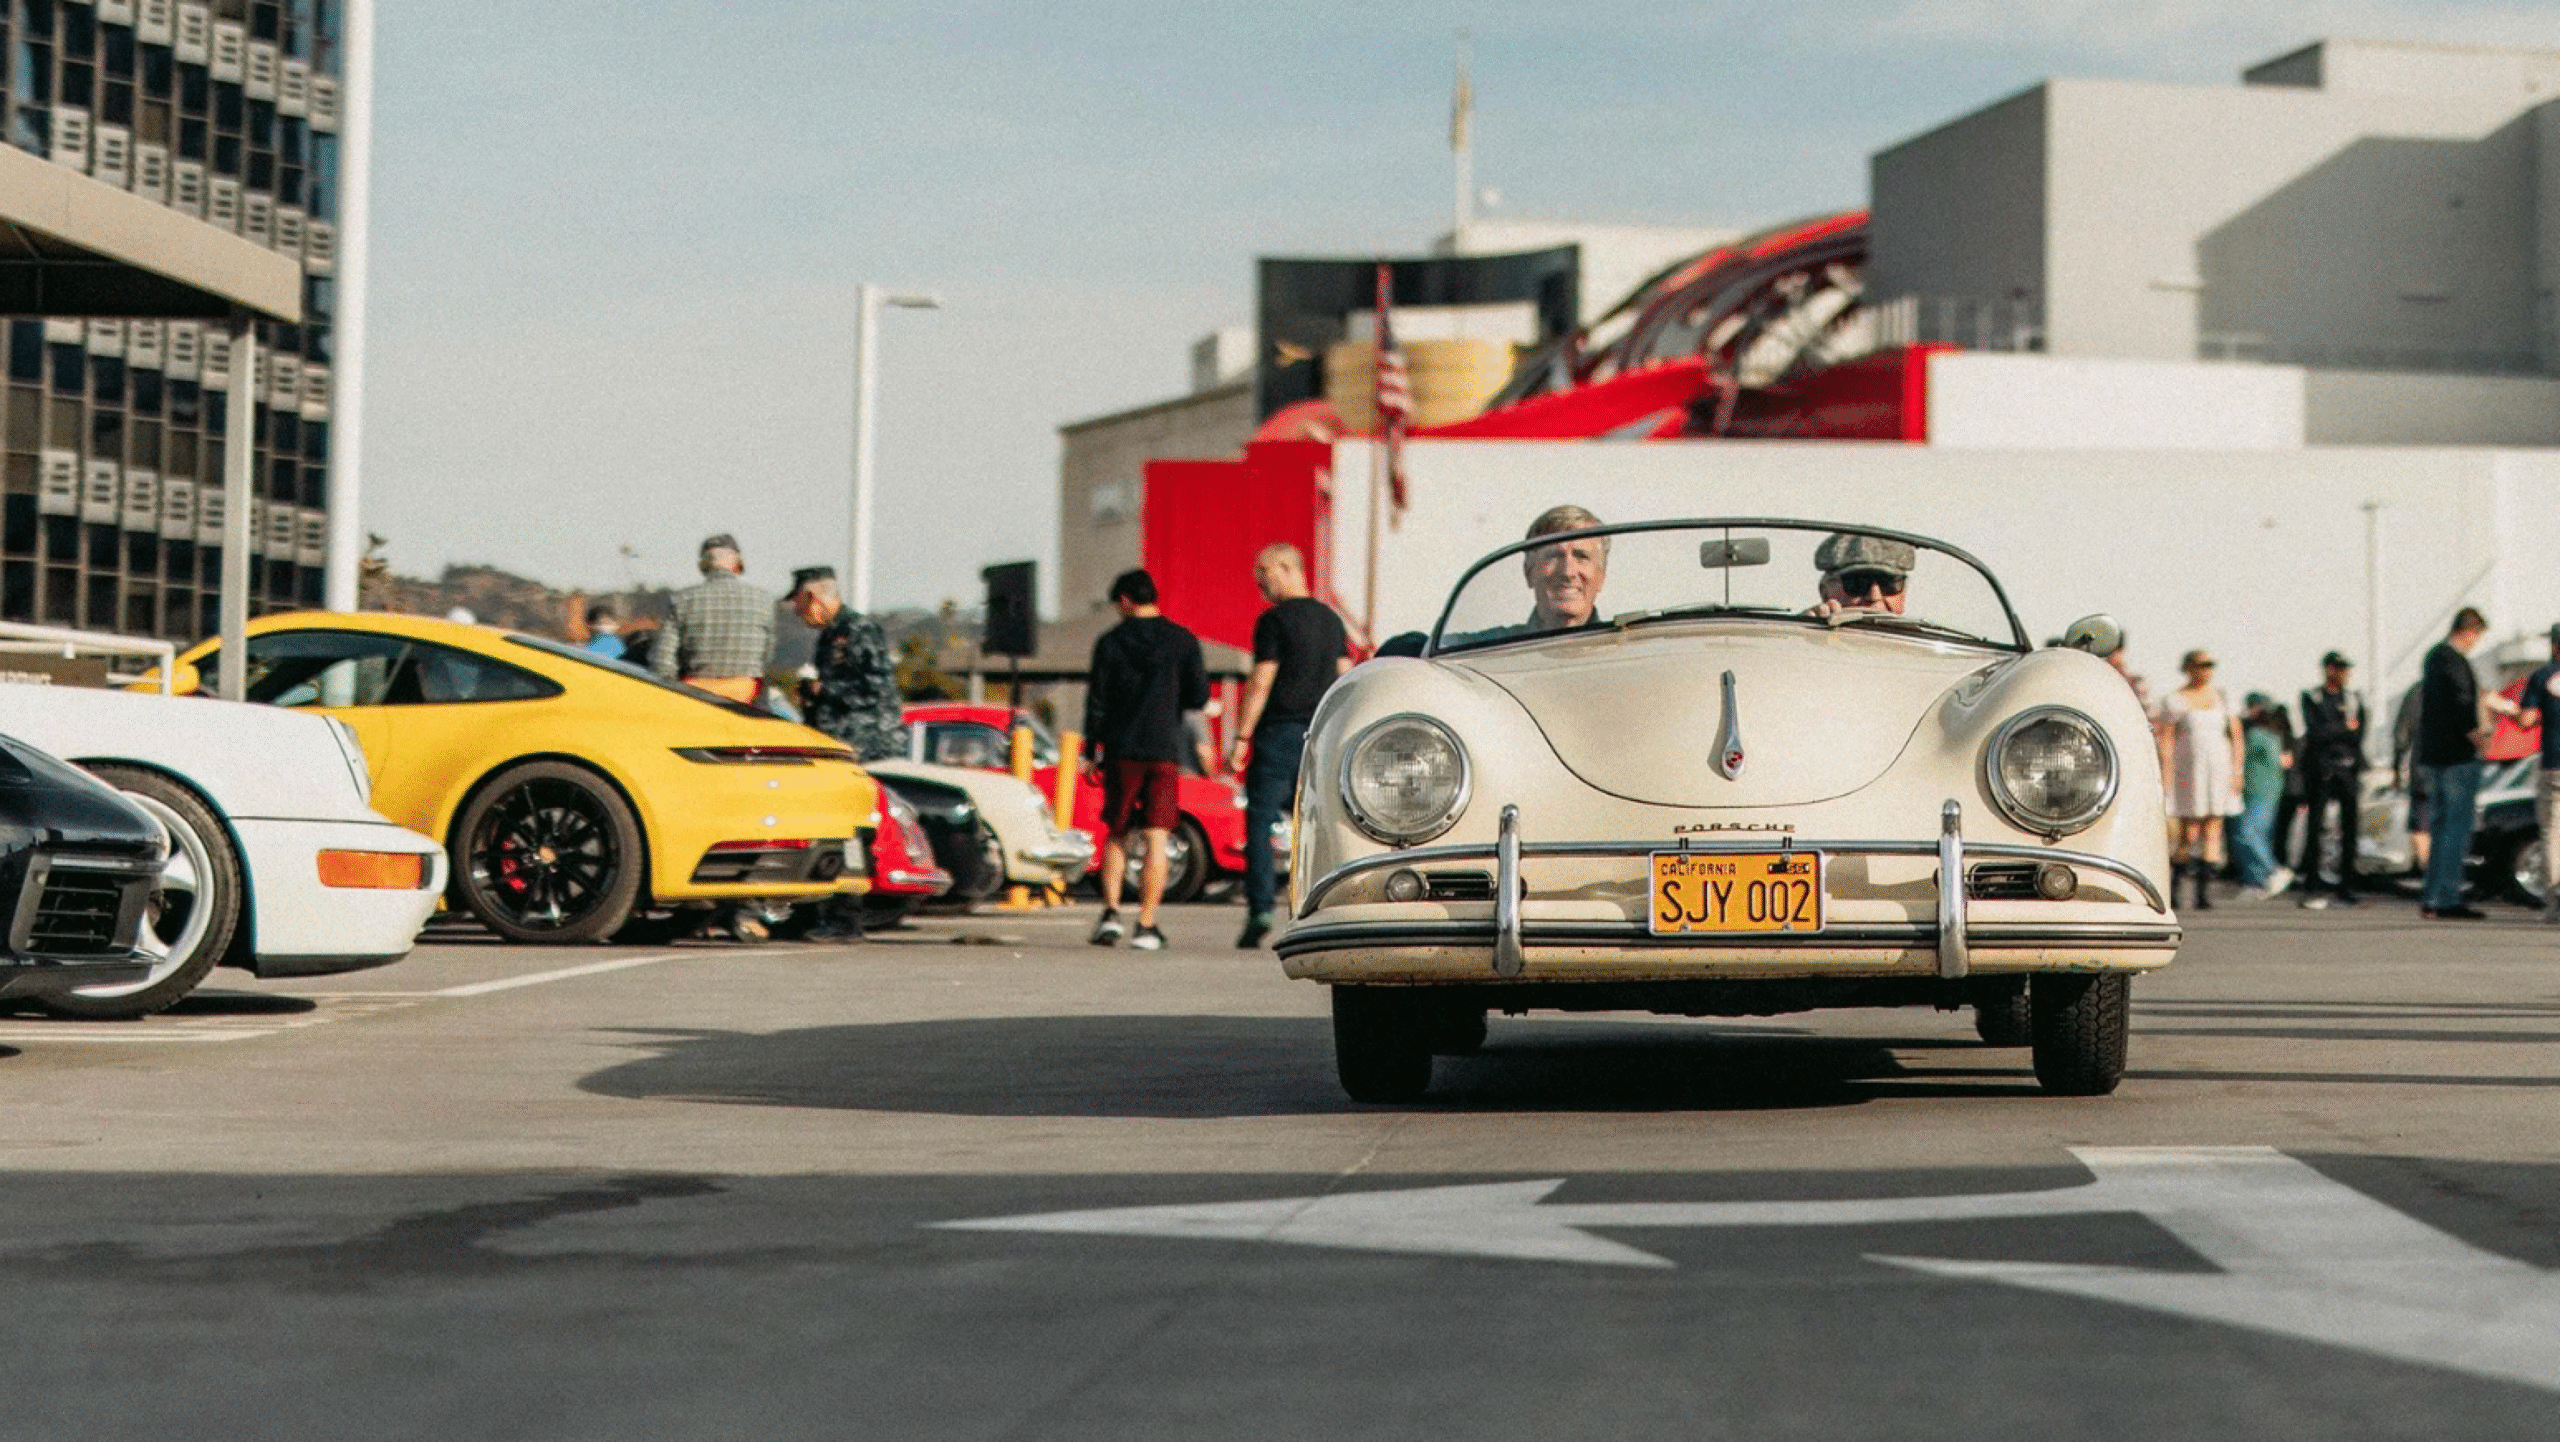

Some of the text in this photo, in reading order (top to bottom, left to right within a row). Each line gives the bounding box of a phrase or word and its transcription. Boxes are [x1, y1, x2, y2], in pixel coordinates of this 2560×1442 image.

[1674, 823, 1795, 834] PORSCHE
[1661, 863, 1736, 876] CALIFORNIA
[1661, 879, 1811, 923] SJY 002
